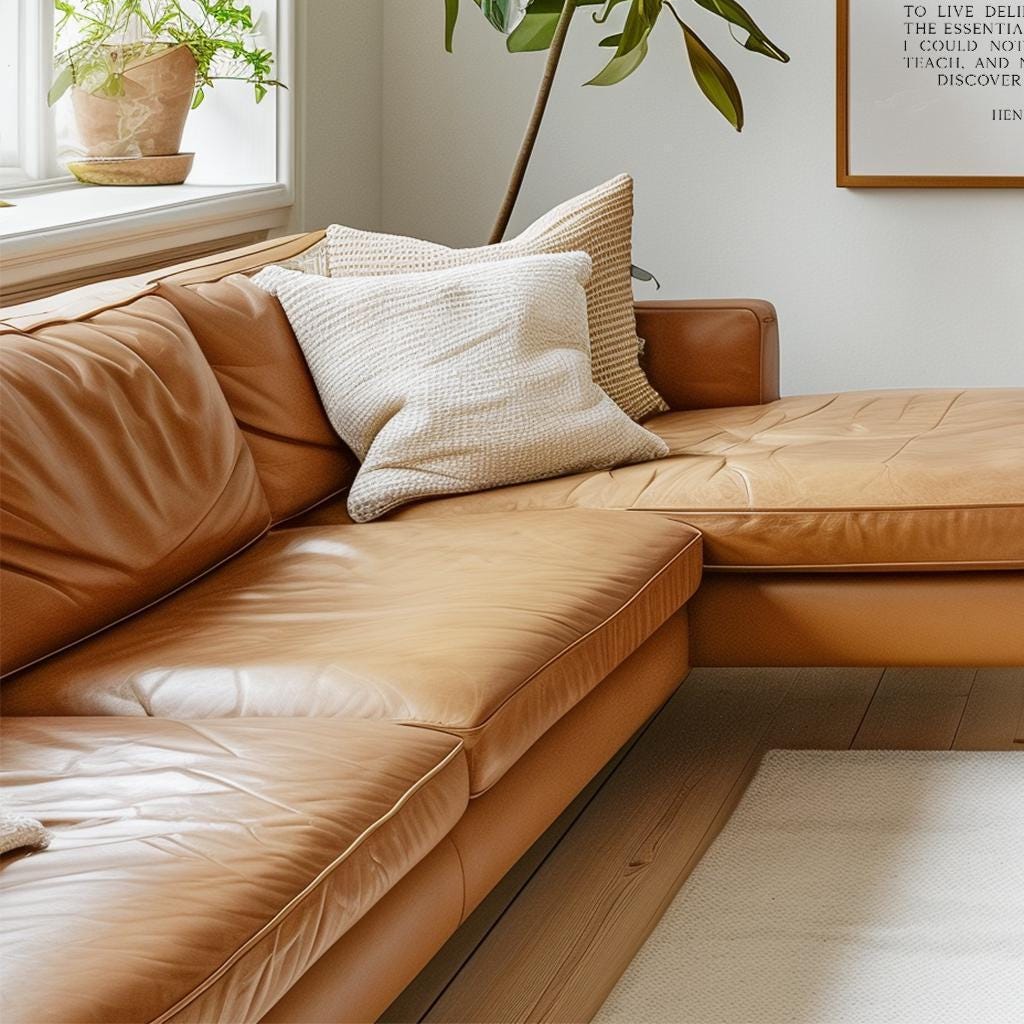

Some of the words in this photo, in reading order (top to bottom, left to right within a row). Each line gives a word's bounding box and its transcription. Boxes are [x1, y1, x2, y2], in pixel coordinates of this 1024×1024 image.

[903, 5, 927, 18] TO
[937, 5, 974, 18] LIVE
[903, 23, 937, 36] THE
[903, 40, 908, 53] I
[919, 40, 978, 53] COULD
[990, 40, 1024, 53] NOT
[974, 57, 1010, 70] AND
[937, 74, 1022, 87] DISCOVER
